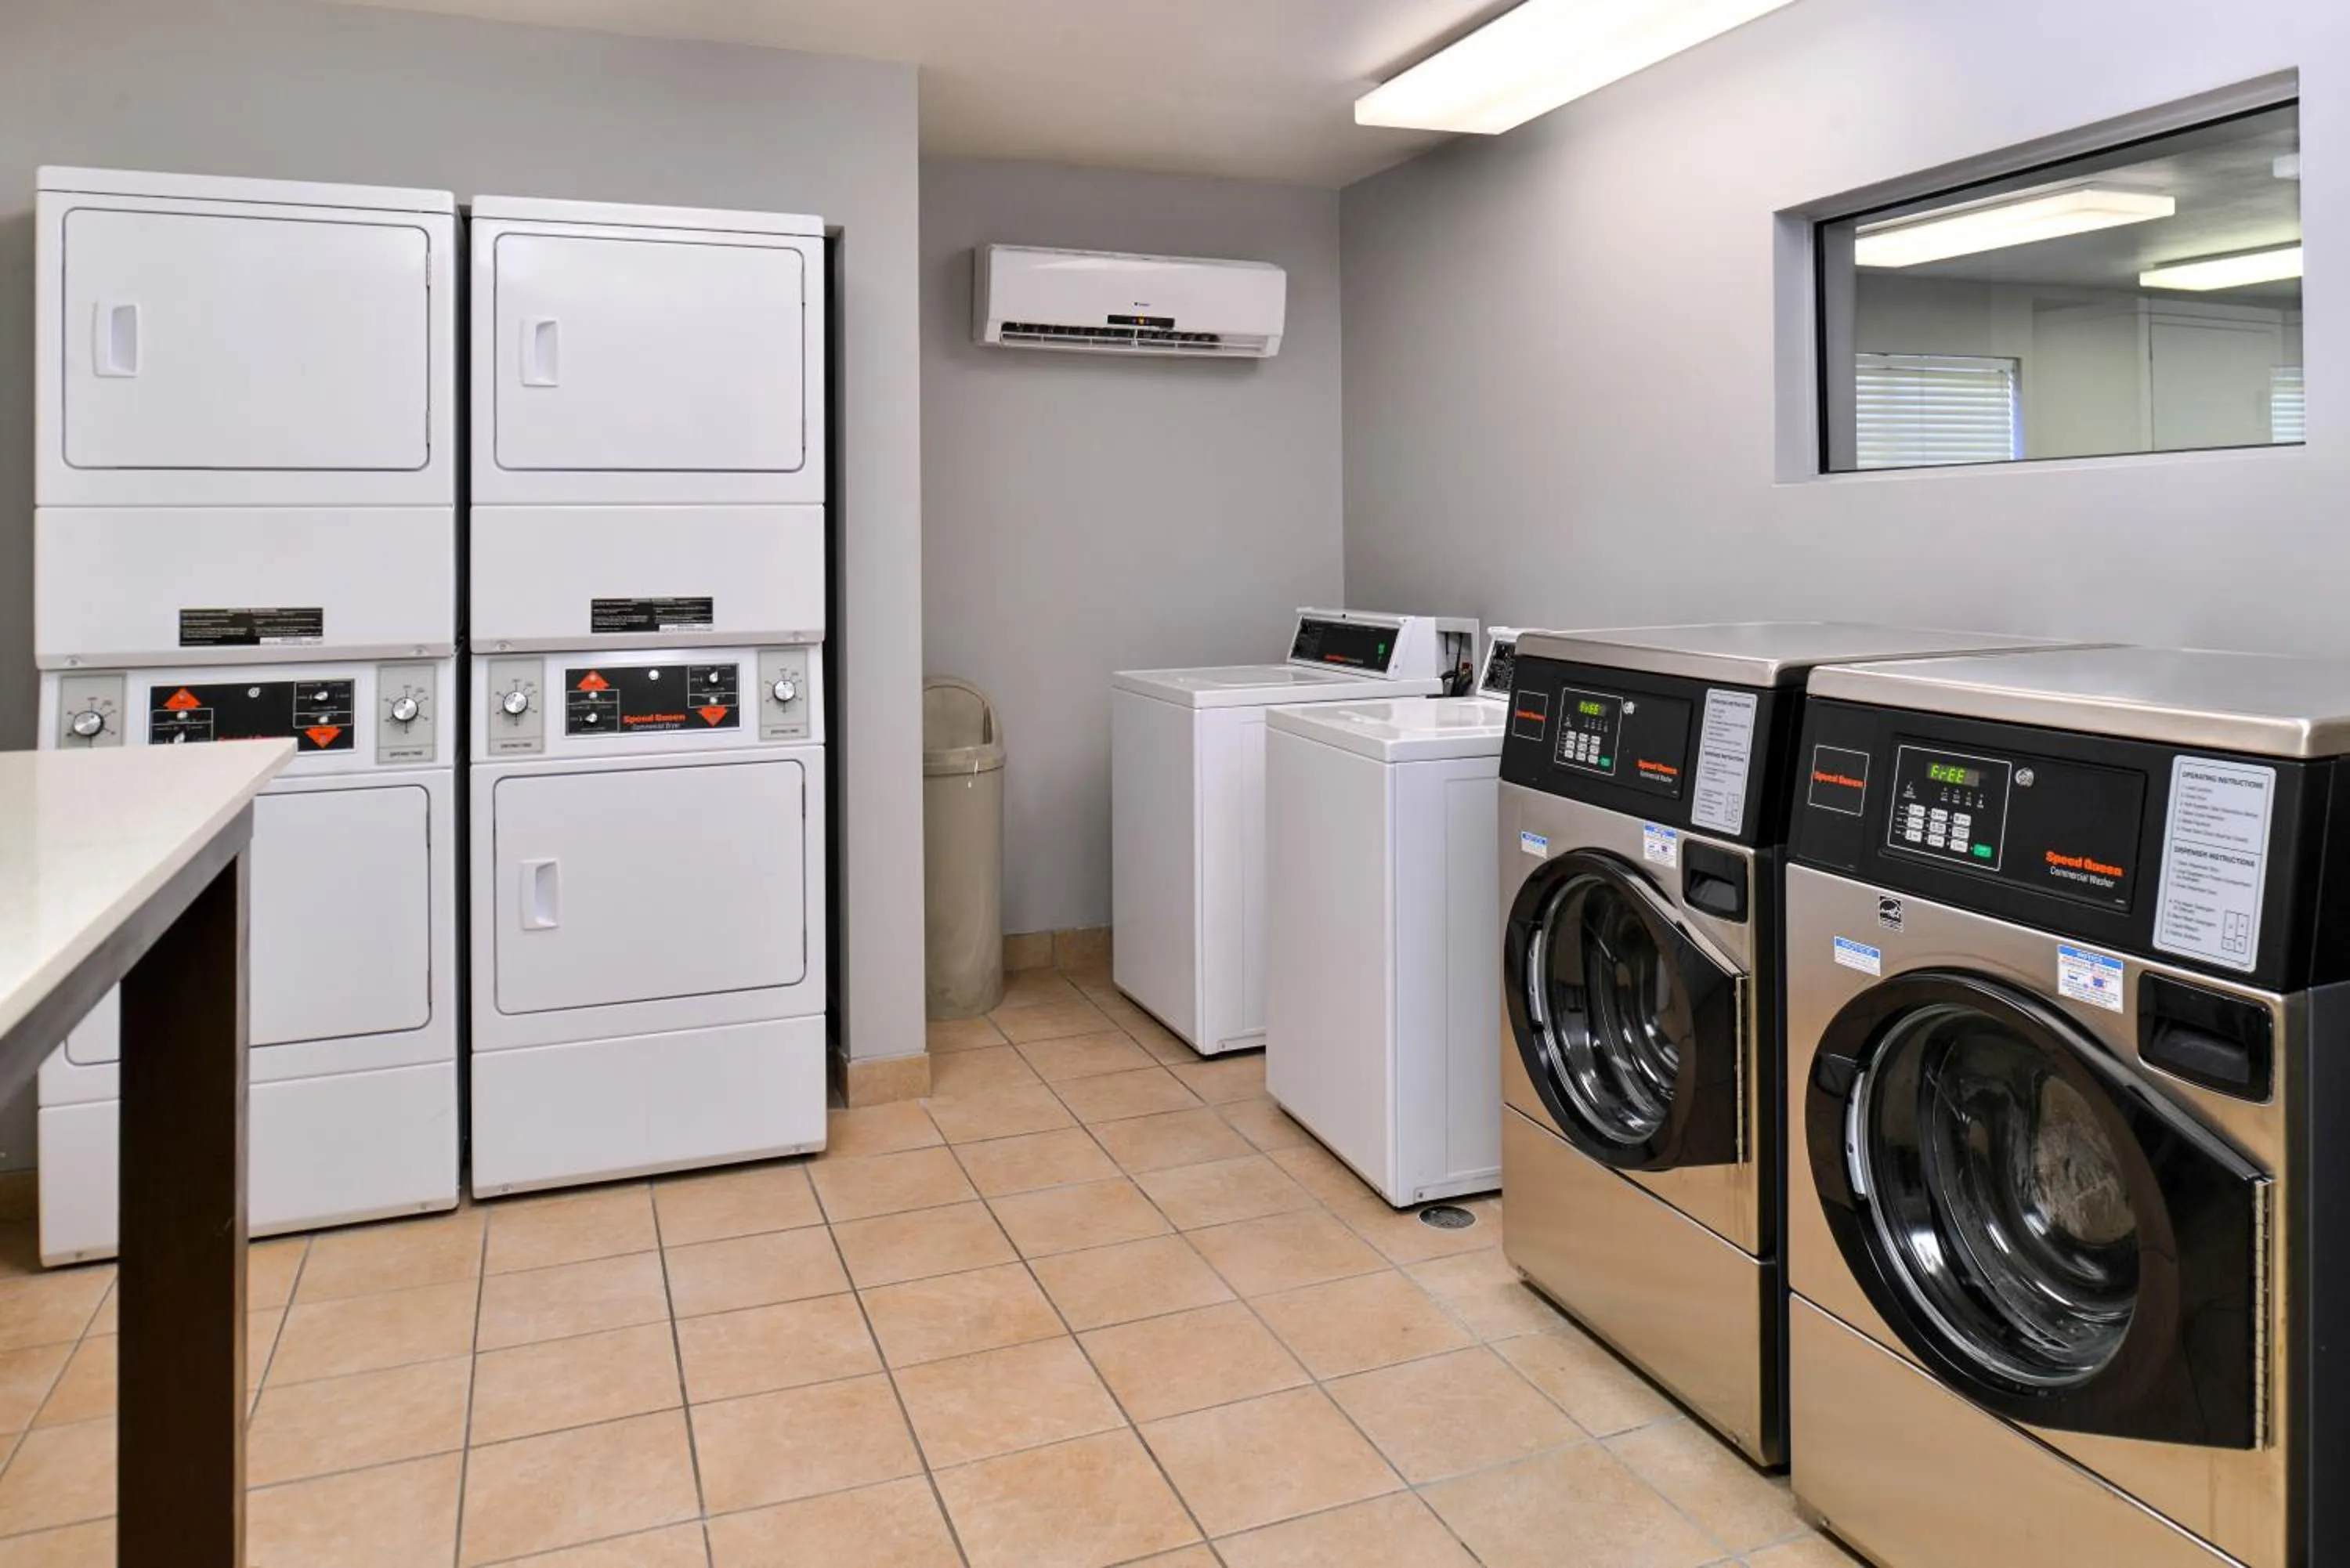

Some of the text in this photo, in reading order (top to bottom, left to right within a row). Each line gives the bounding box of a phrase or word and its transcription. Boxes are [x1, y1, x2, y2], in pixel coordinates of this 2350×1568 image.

[624, 714, 653, 724] Speed
[2182, 771, 2263, 789] OPERATING INSTRUCTIONS
[2046, 851, 2124, 876] Speed Queen
[2209, 853, 2255, 867] INSTRUCTIONS
[2050, 865, 2114, 887] Commercial Washer
